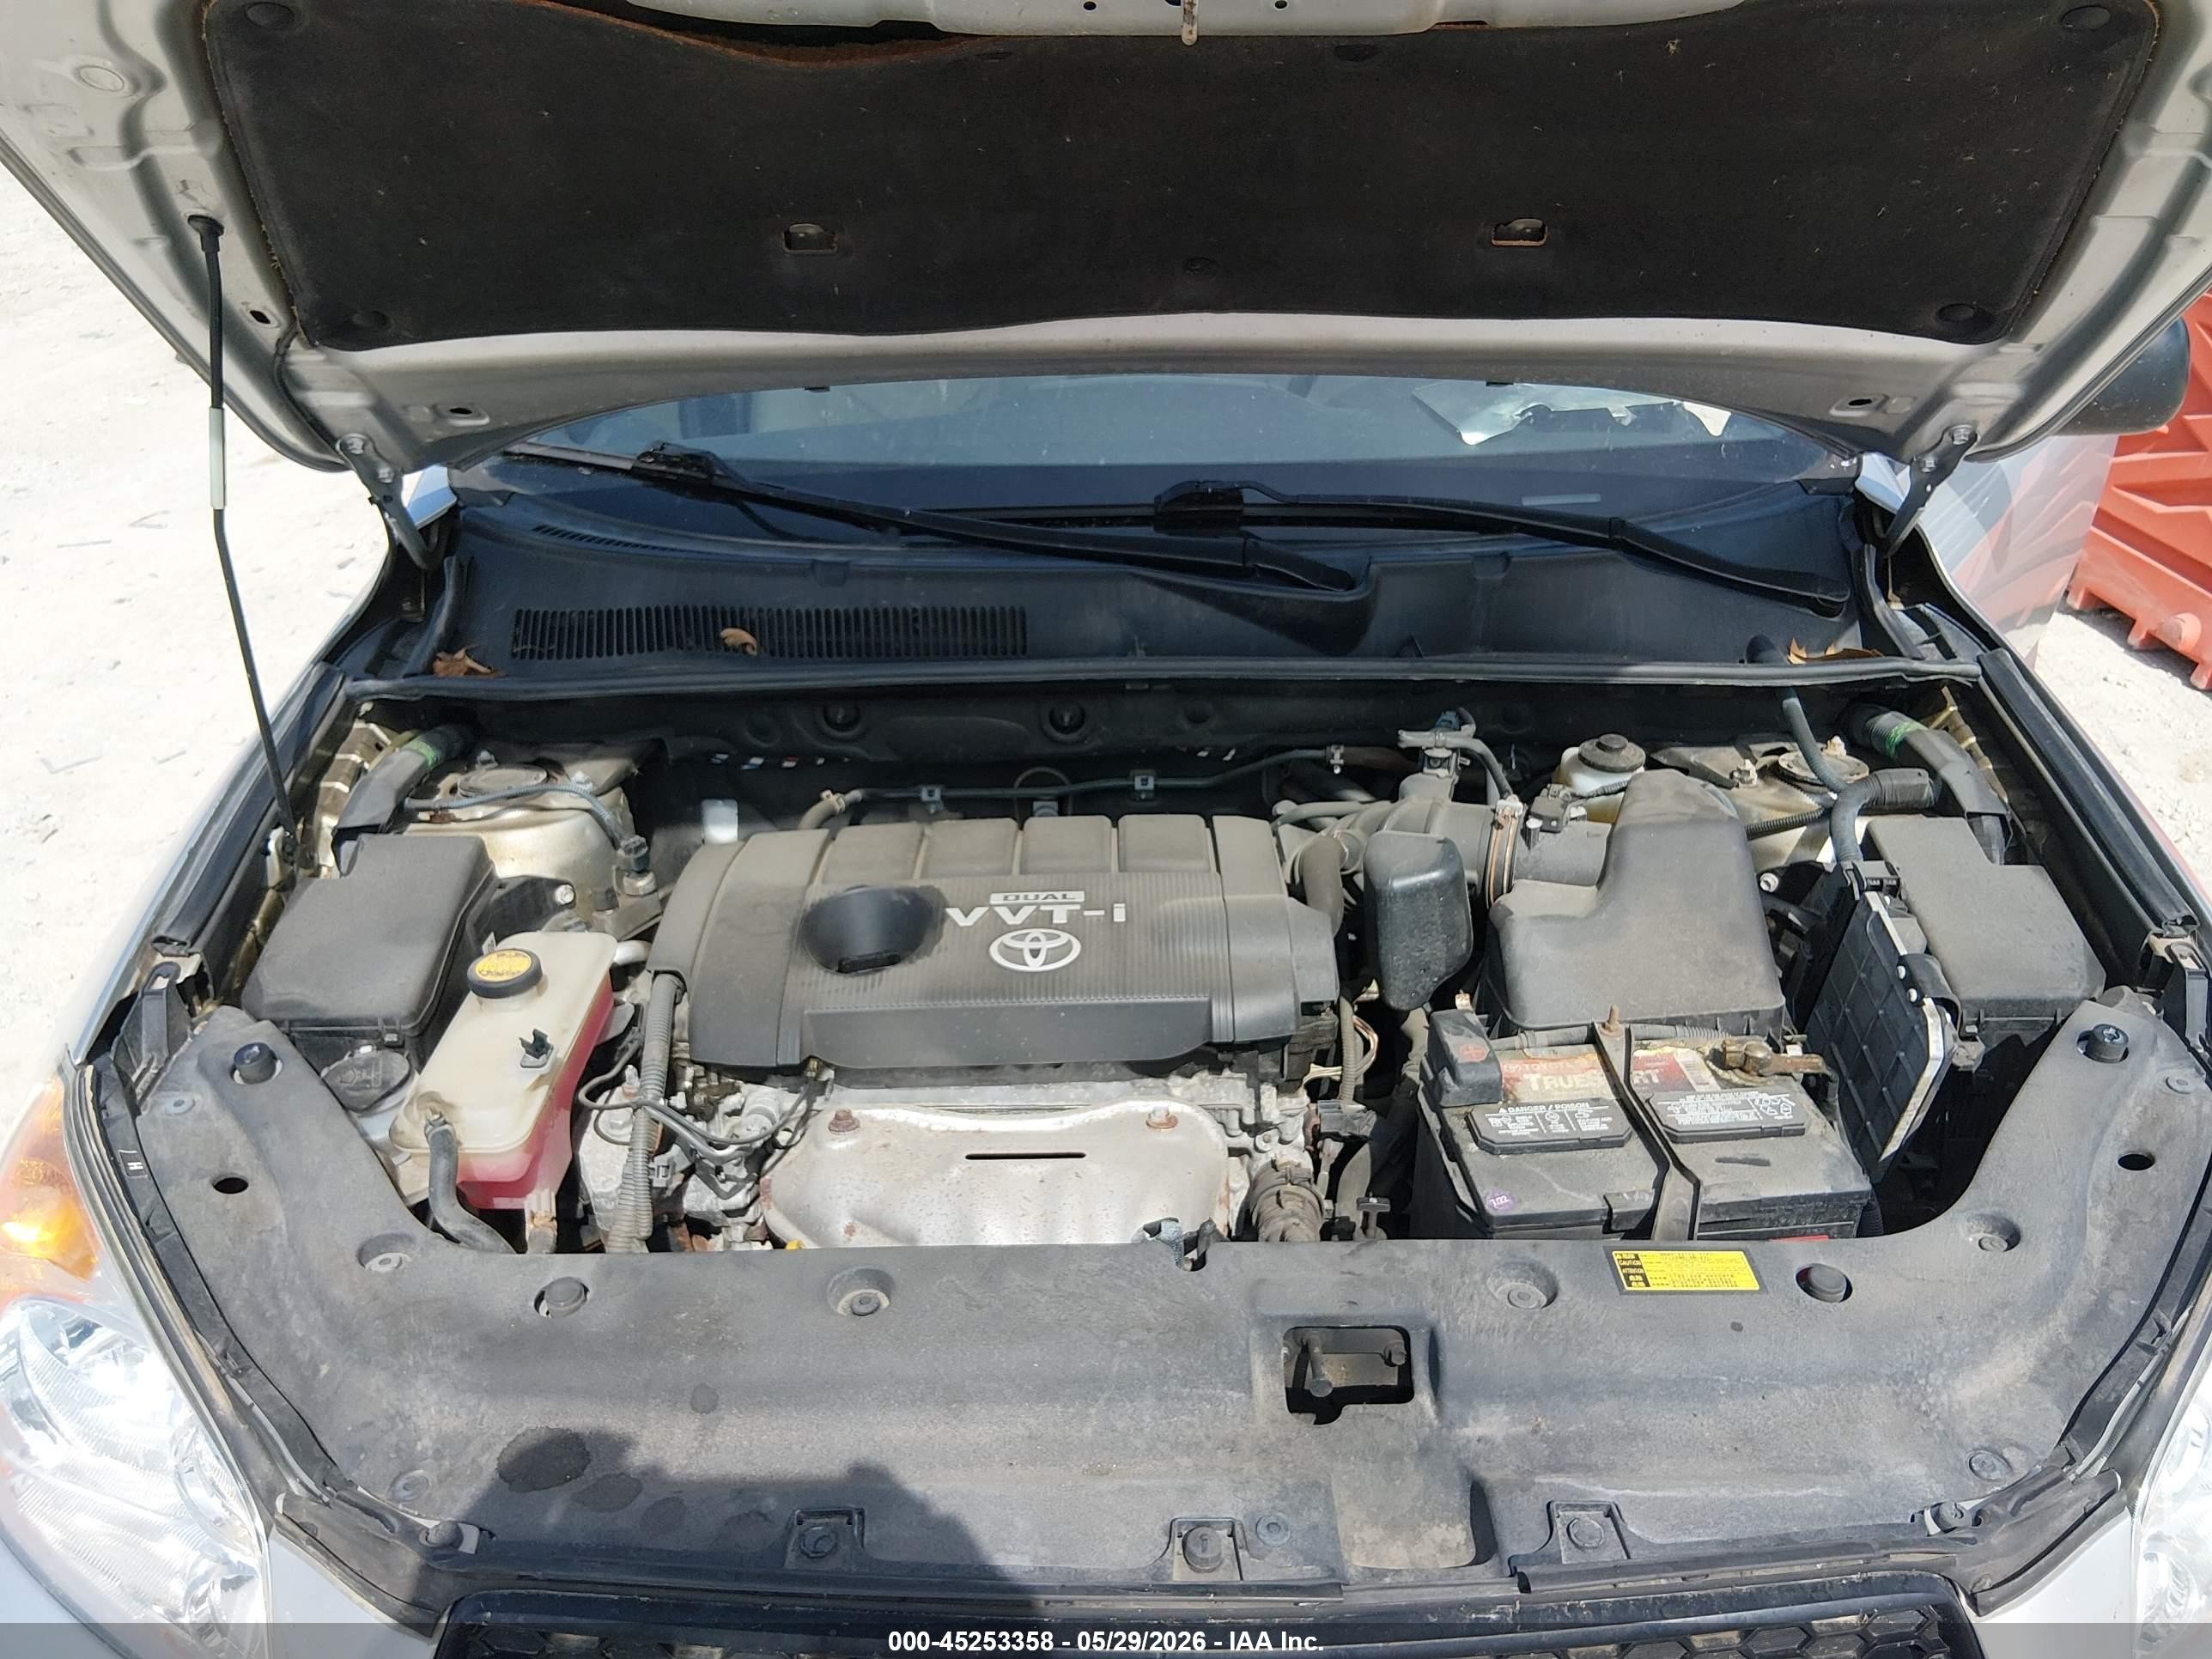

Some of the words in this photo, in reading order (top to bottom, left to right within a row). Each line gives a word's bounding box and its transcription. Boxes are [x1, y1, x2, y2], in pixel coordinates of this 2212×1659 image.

[945, 903, 1126, 927] VVT-i
[1508, 1104, 1546, 1114] DANGER
[1554, 1102, 1590, 1110] POISON
